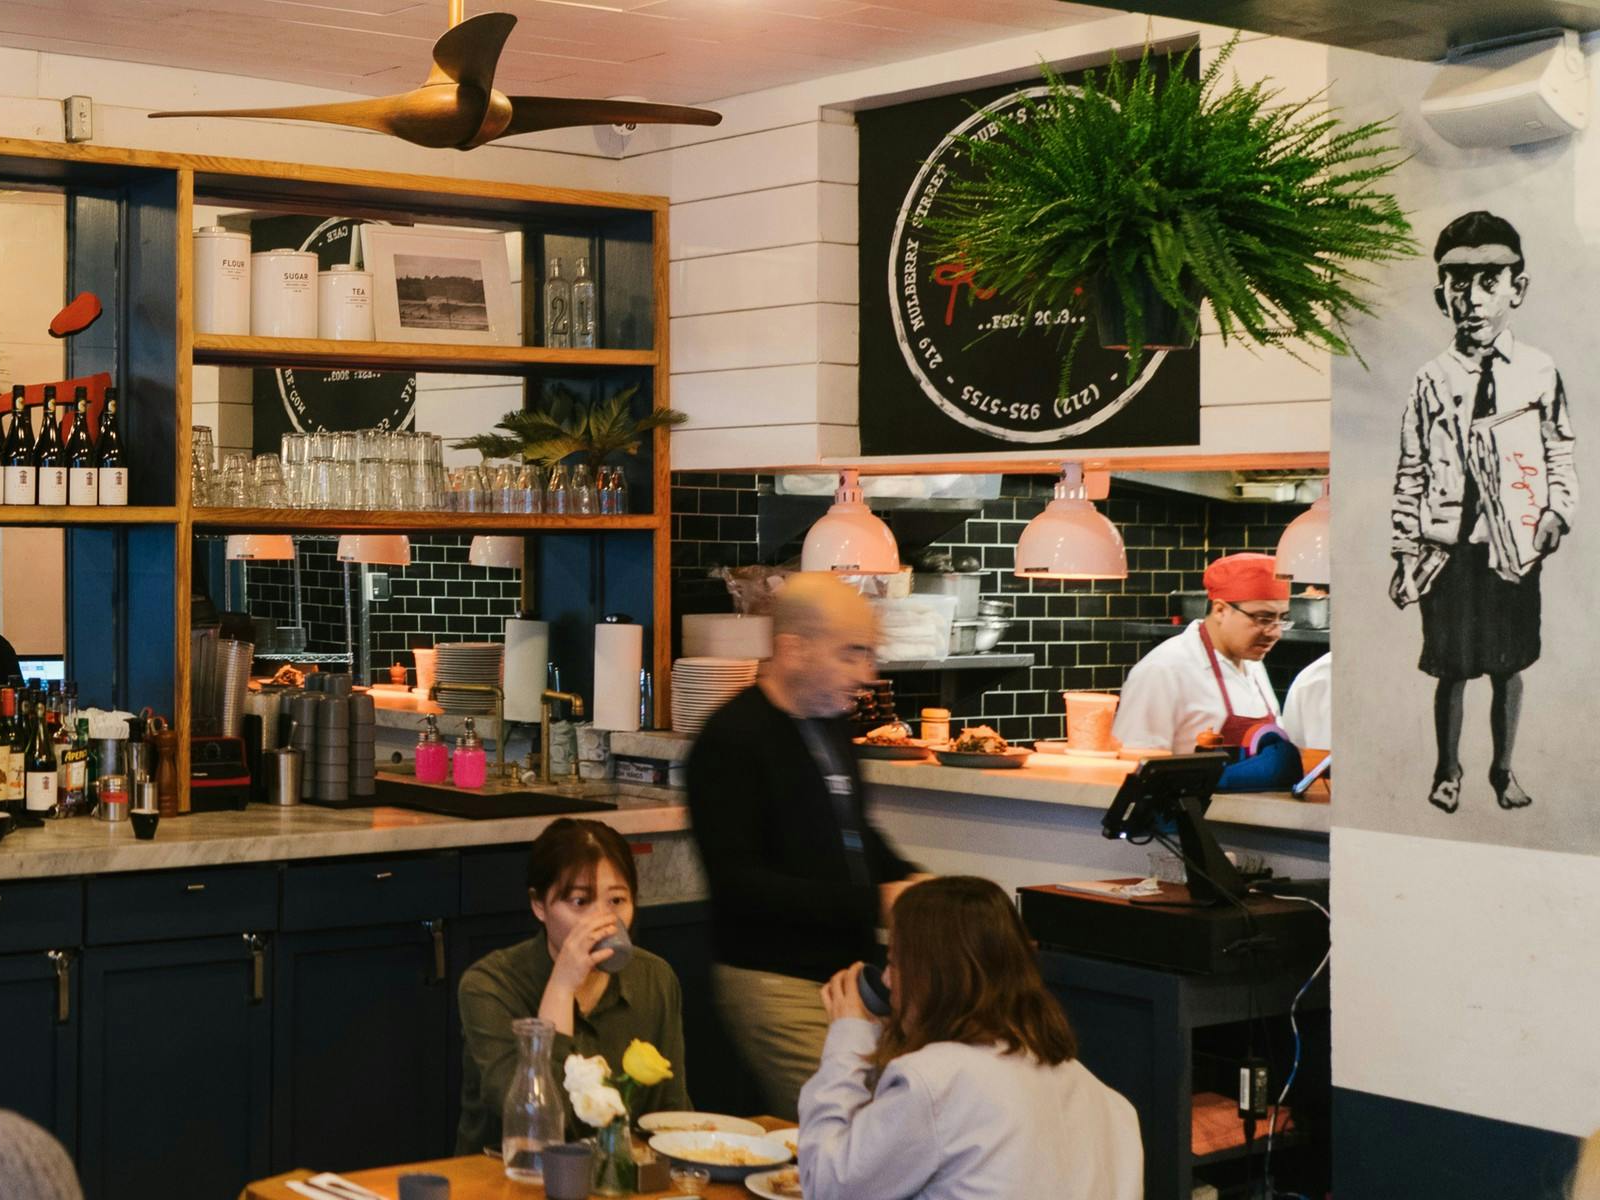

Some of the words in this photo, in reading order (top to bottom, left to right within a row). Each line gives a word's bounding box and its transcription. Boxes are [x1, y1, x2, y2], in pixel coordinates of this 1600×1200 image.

[911, 163, 949, 230] STREET
[222, 259, 245, 268] FLOUR
[283, 273, 309, 281] SUGAR
[352, 288, 366, 296] TEA
[903, 237, 926, 333] MULBERRY
[918, 337, 944, 369] 219
[961, 385, 1041, 421] 925-5755
[1053, 383, 1101, 419] (212)
